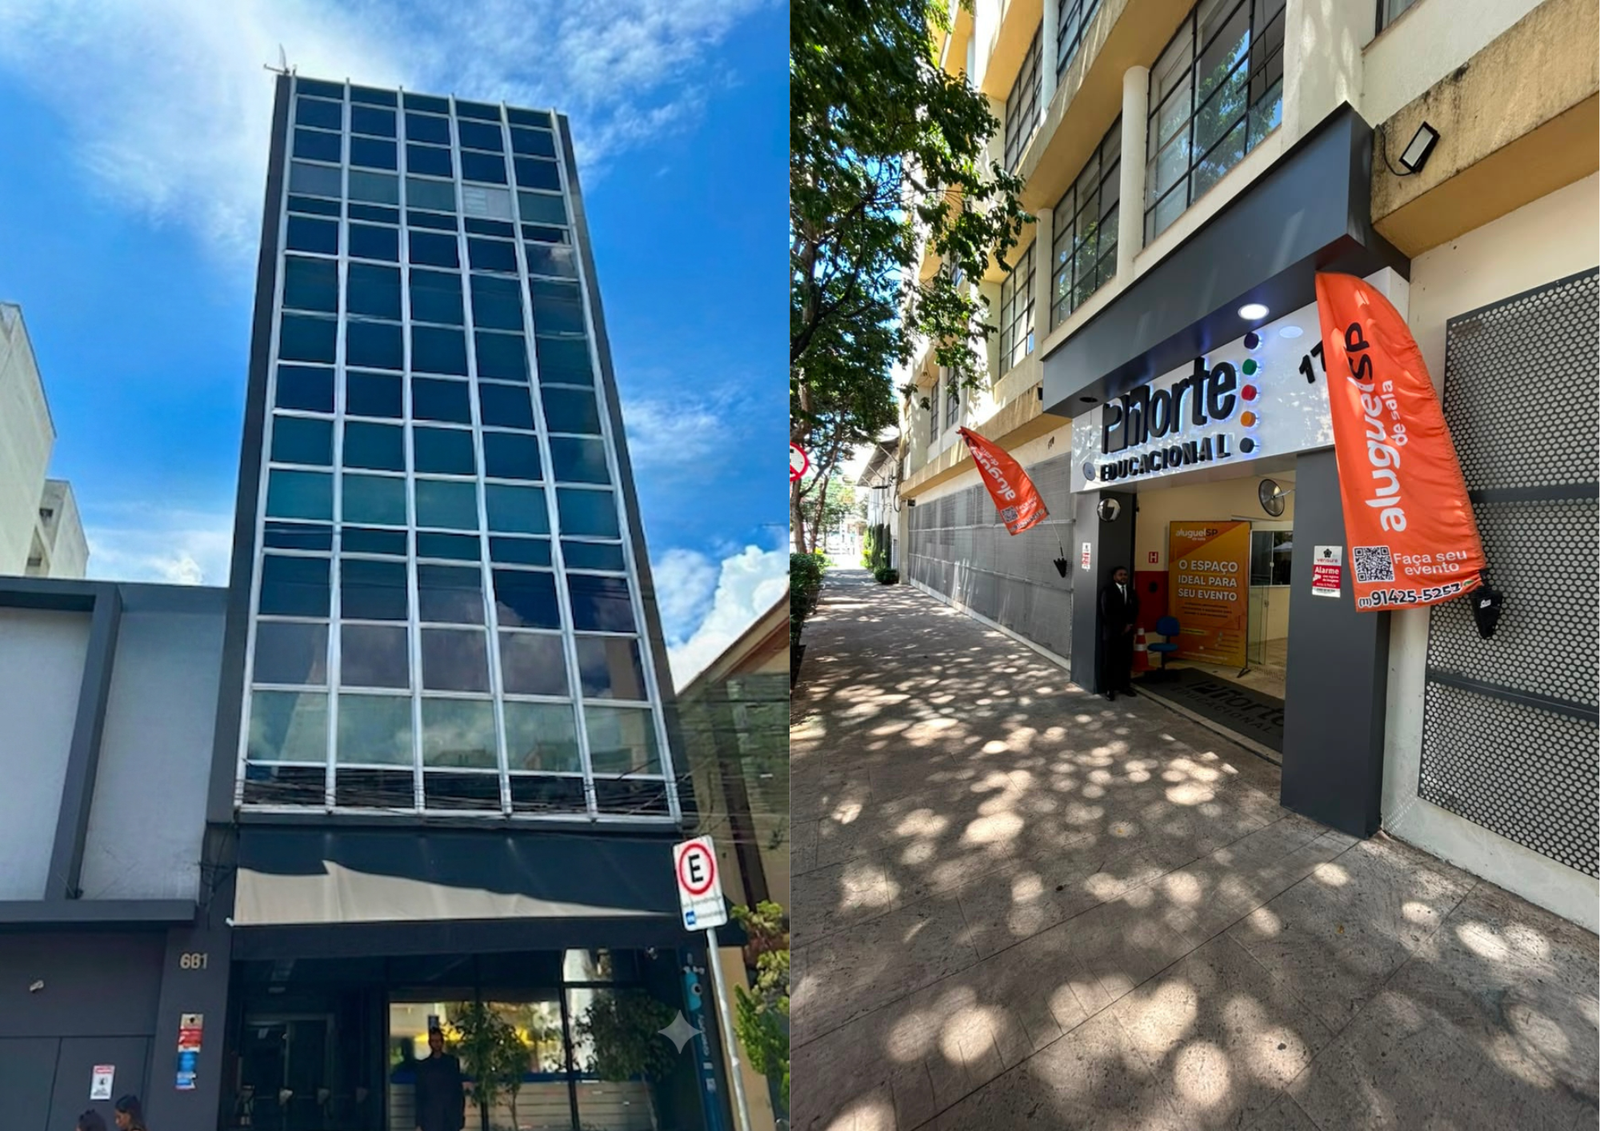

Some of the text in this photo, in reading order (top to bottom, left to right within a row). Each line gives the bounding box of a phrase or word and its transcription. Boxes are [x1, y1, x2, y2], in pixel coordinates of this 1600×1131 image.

[1102, 357, 1237, 454] Phorte
[1381, 380, 1408, 446] de sala
[1100, 434, 1232, 482] EDUCACIONAL
[1393, 550, 1467, 566] Faça seu
[1179, 560, 1238, 575] O ESPAÇO
[1314, 566, 1340, 575] Alarme
[1404, 562, 1460, 576] evento
[1178, 575, 1238, 587] IDEAL PARA
[1178, 588, 1237, 601] SEU EVENTO
[688, 854, 704, 883] E
